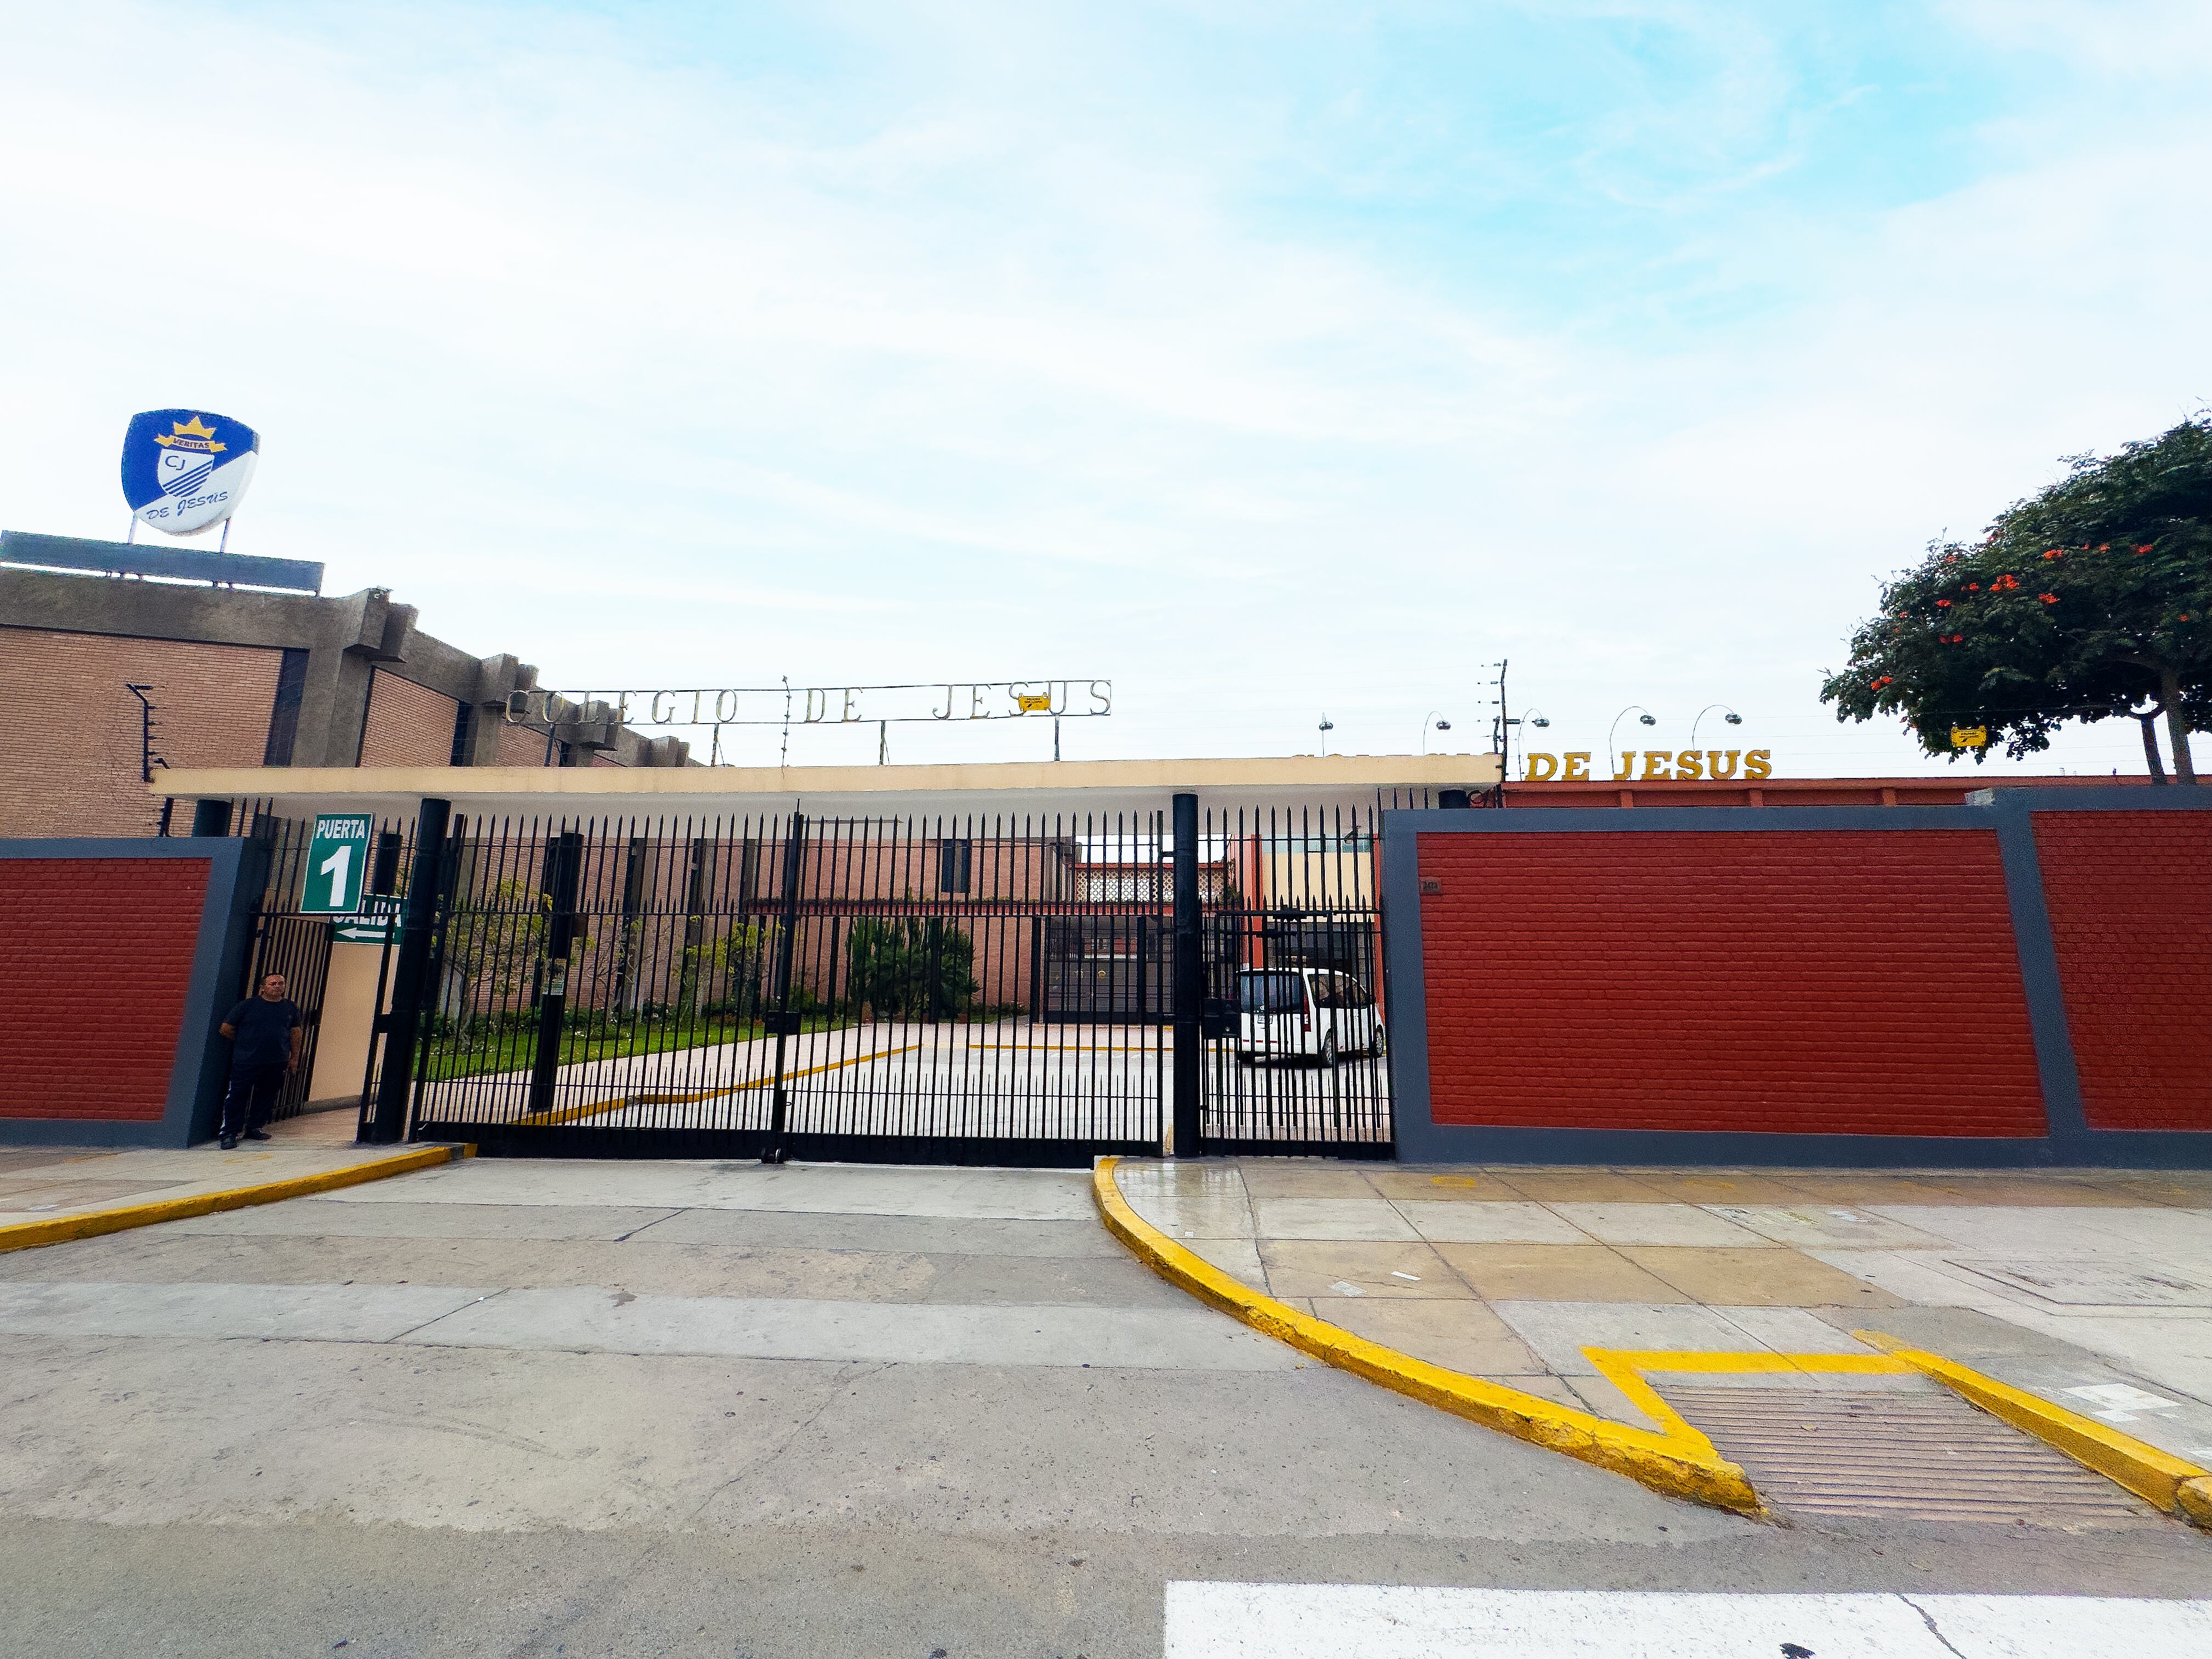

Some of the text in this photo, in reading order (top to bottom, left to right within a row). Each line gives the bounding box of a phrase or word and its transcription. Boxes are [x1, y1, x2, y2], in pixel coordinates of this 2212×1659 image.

[173, 437, 210, 449] VERITAS
[165, 455, 186, 471] CJ
[146, 507, 170, 520] DE
[505, 680, 1111, 724] COLEGIO DE JESUS
[1525, 749, 1772, 781] DE JESUS
[315, 819, 365, 839] PUERTA
[320, 845, 352, 907] 1
